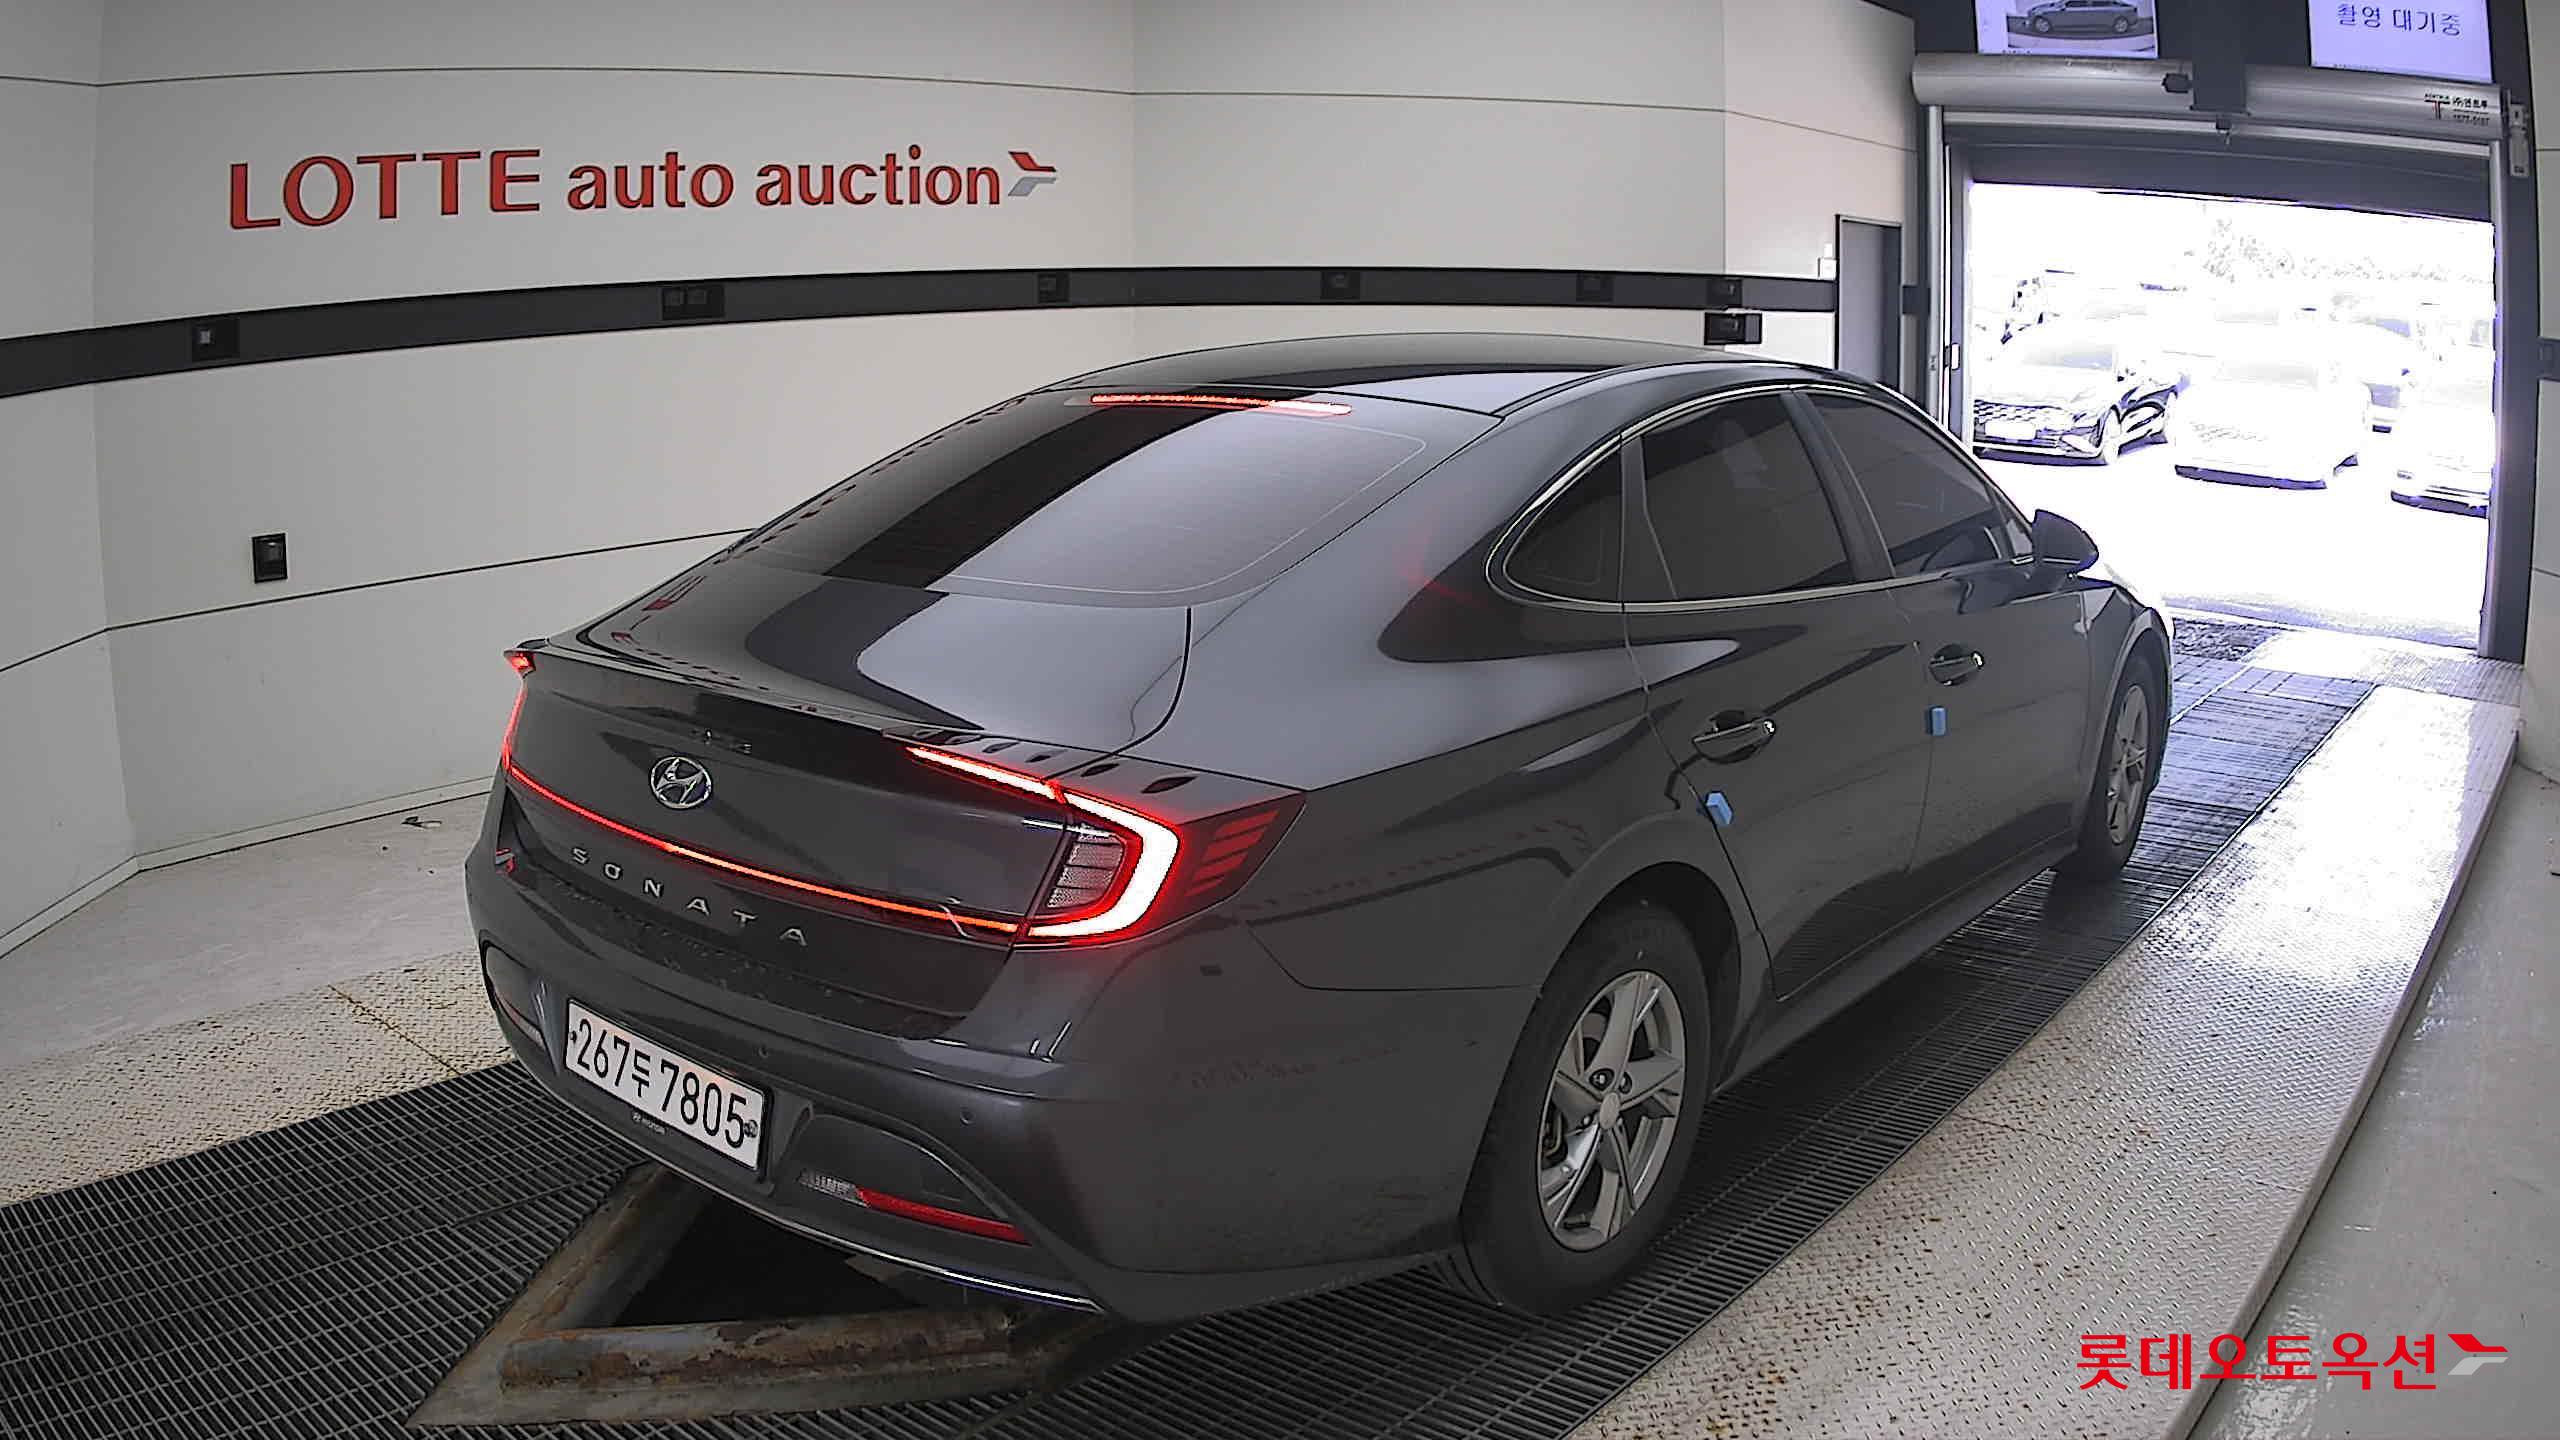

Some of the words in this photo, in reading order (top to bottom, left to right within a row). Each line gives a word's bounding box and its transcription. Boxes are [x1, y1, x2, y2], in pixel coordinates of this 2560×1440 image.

[2338, 3, 2381, 28] 촬영
[2392, 9, 2461, 37] 대기중
[229, 149, 542, 230] LOTTE
[567, 152, 735, 210] auto
[755, 144, 1001, 207] auction
[572, 847, 808, 947] SONATA
